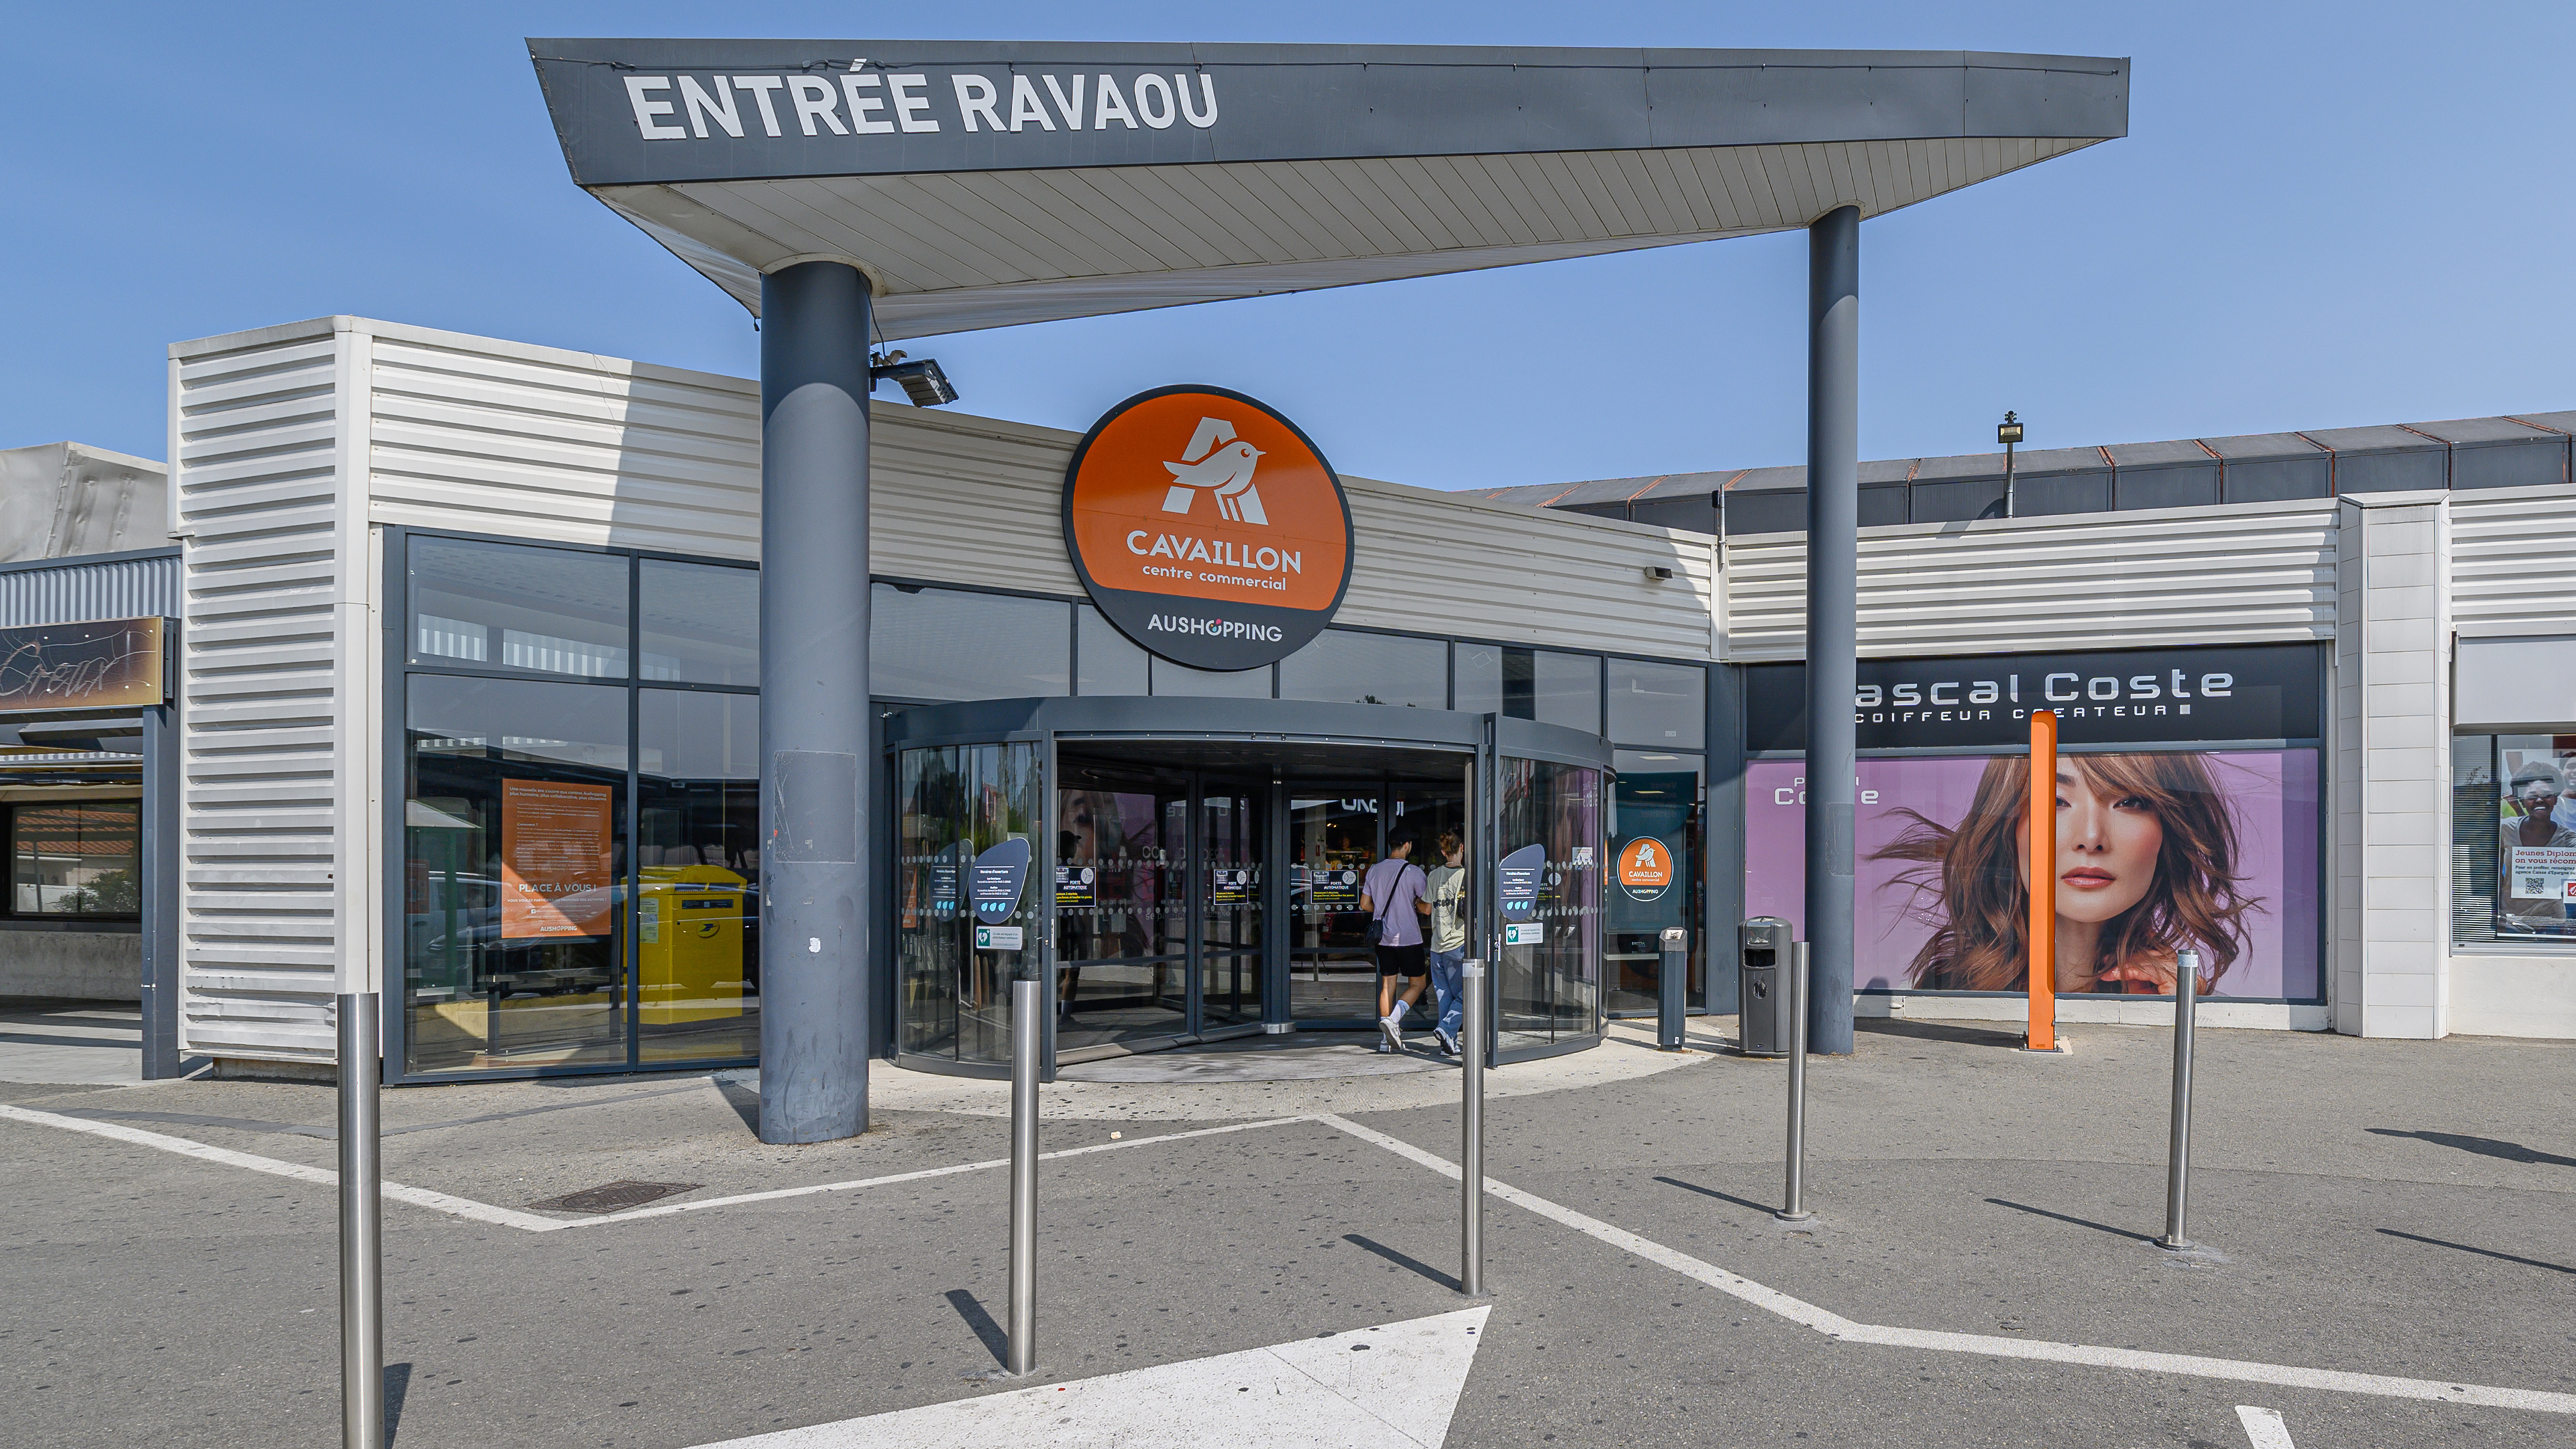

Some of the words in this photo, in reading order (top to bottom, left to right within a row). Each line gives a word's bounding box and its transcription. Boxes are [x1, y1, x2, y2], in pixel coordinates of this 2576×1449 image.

[623, 58, 940, 140] ENTRÉE
[951, 73, 1218, 133] RAVAOU
[1126, 530, 1301, 575] CAVAILLON
[1142, 565, 1193, 580] centre
[1199, 571, 1287, 591] commercial
[1147, 614, 1283, 642] AUSHOPPING
[1856, 674, 2018, 707] ascal
[2045, 669, 2233, 702] Coste
[1855, 710, 1990, 723] COIFFEUR
[2012, 705, 2166, 719] CEATEUR
[519, 883, 552, 892] PLACE
[554, 882, 561, 892] À
[564, 883, 591, 892] VOUS
